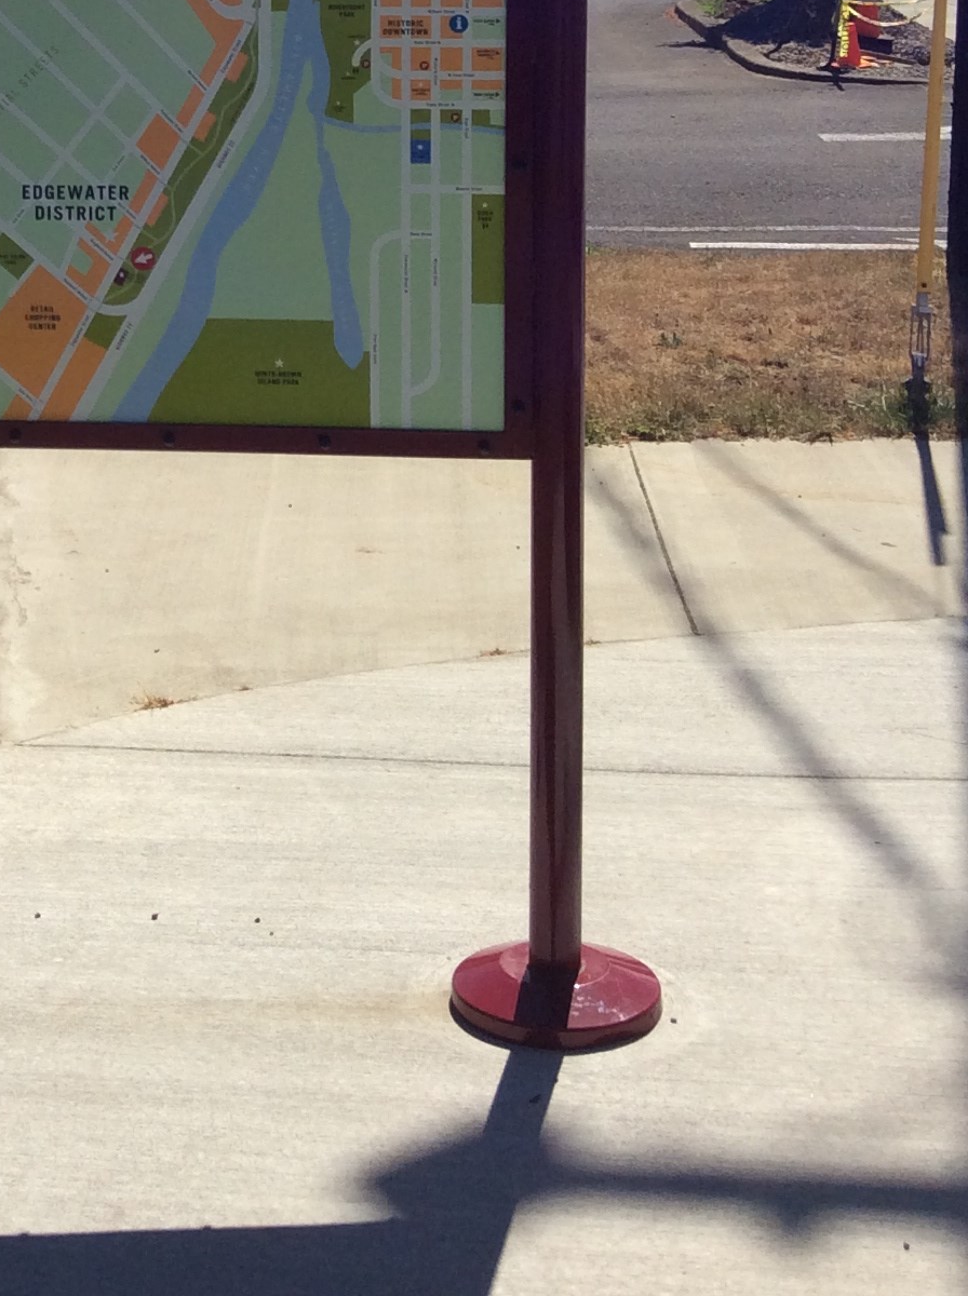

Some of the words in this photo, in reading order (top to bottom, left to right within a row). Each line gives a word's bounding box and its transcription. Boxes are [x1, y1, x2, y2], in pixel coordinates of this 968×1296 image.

[387, 19, 424, 27] HISTORIC
[382, 28, 429, 36] DOWNTOWN
[22, 184, 130, 201] EDGEWATER
[35, 205, 117, 221] DISTRICT
[30, 305, 54, 313] RETAIL
[24, 313, 61, 321] SHOPPING
[28, 322, 57, 330] CENTER
